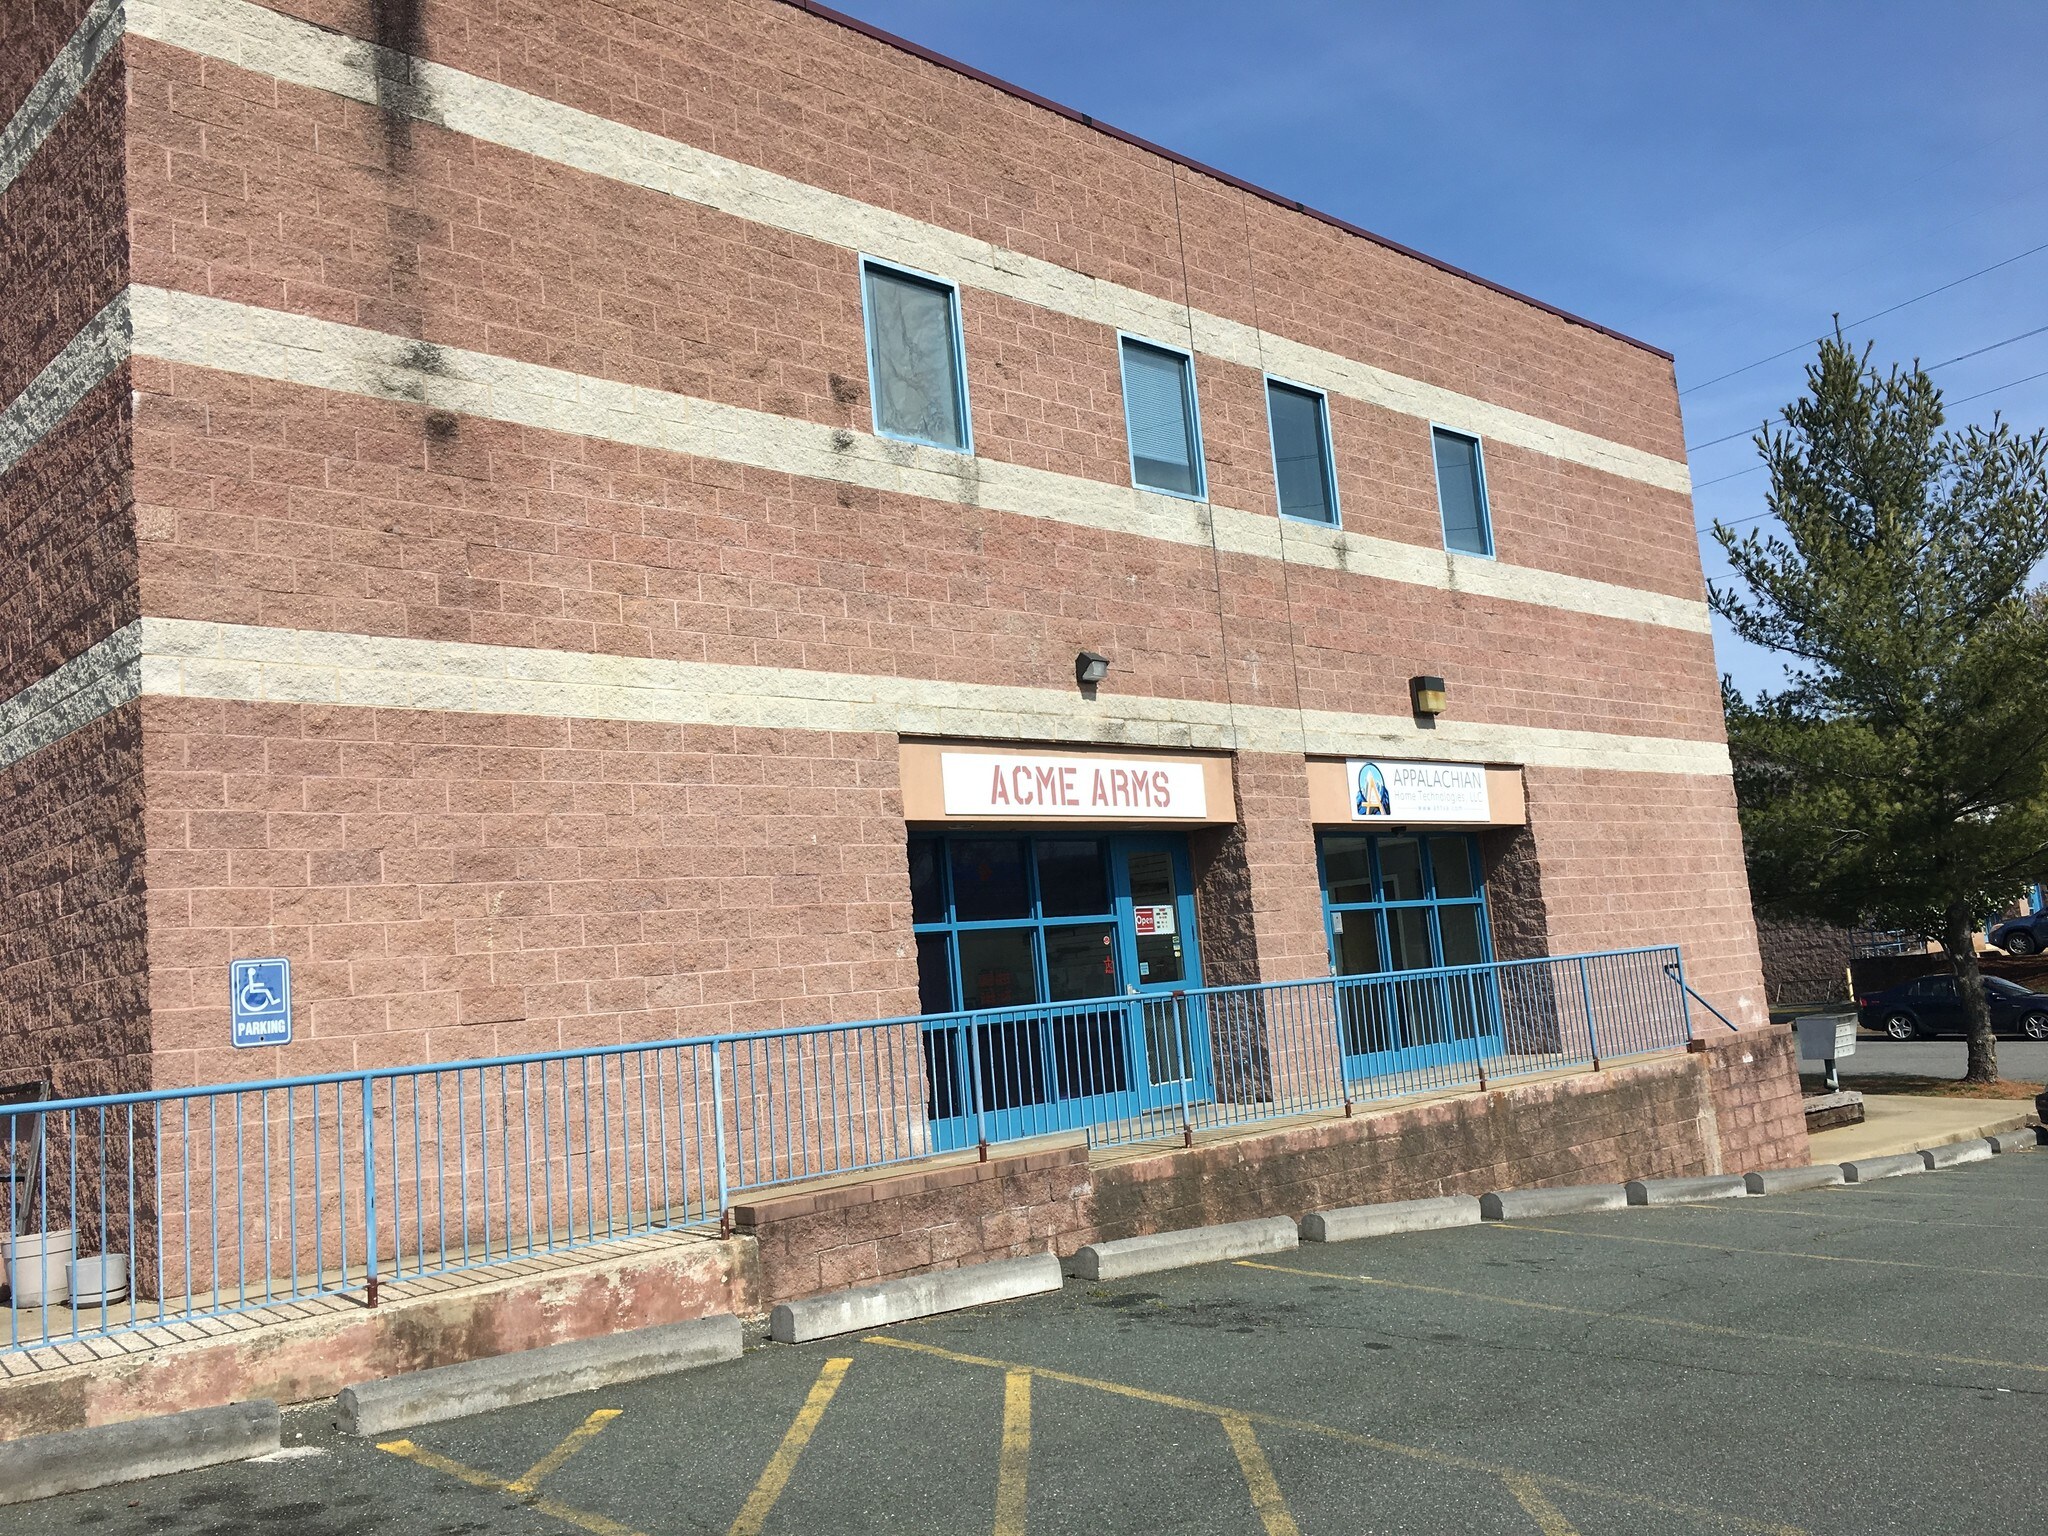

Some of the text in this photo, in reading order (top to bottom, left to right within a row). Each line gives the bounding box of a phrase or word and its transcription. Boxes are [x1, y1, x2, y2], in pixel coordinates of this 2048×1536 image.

[991, 765, 1171, 807] ACME ARMS
[1393, 768, 1482, 788] APPALACHIAN
[1394, 790, 1416, 801] Home
[1469, 791, 1483, 803] LLC
[1136, 915, 1153, 926] Open
[238, 1020, 286, 1036] PARKING
